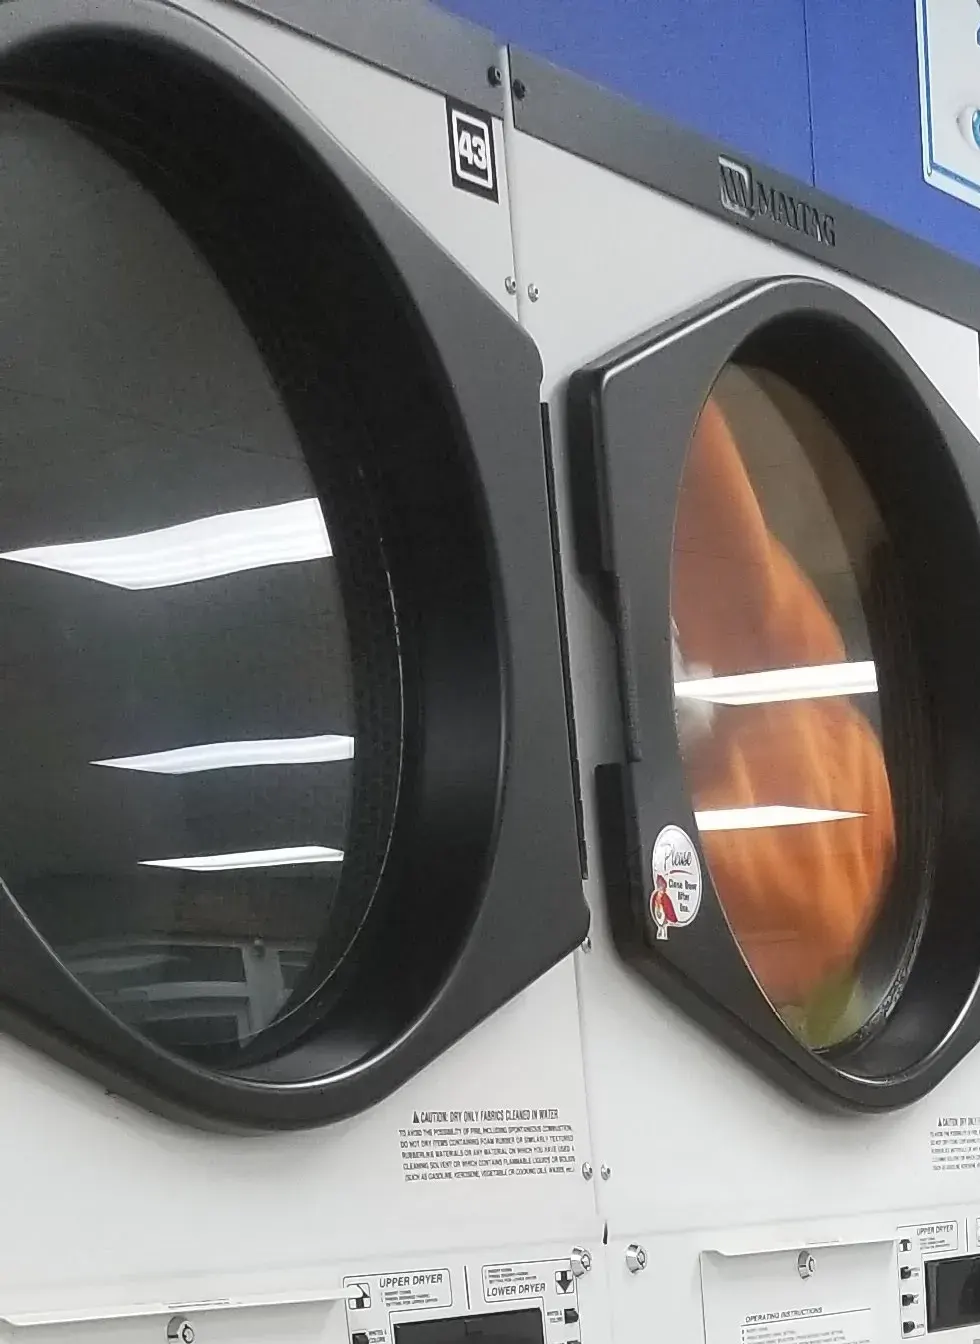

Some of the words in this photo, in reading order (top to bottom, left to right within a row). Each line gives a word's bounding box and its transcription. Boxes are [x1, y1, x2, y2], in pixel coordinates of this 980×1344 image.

[457, 129, 488, 171] 43
[755, 181, 836, 247] MAYTAG
[660, 843, 692, 872] Please
[379, 1276, 410, 1288] UPPER
[413, 1273, 443, 1285] DRYER
[486, 1286, 516, 1297] LOWER
[519, 1283, 546, 1294] DRYER
